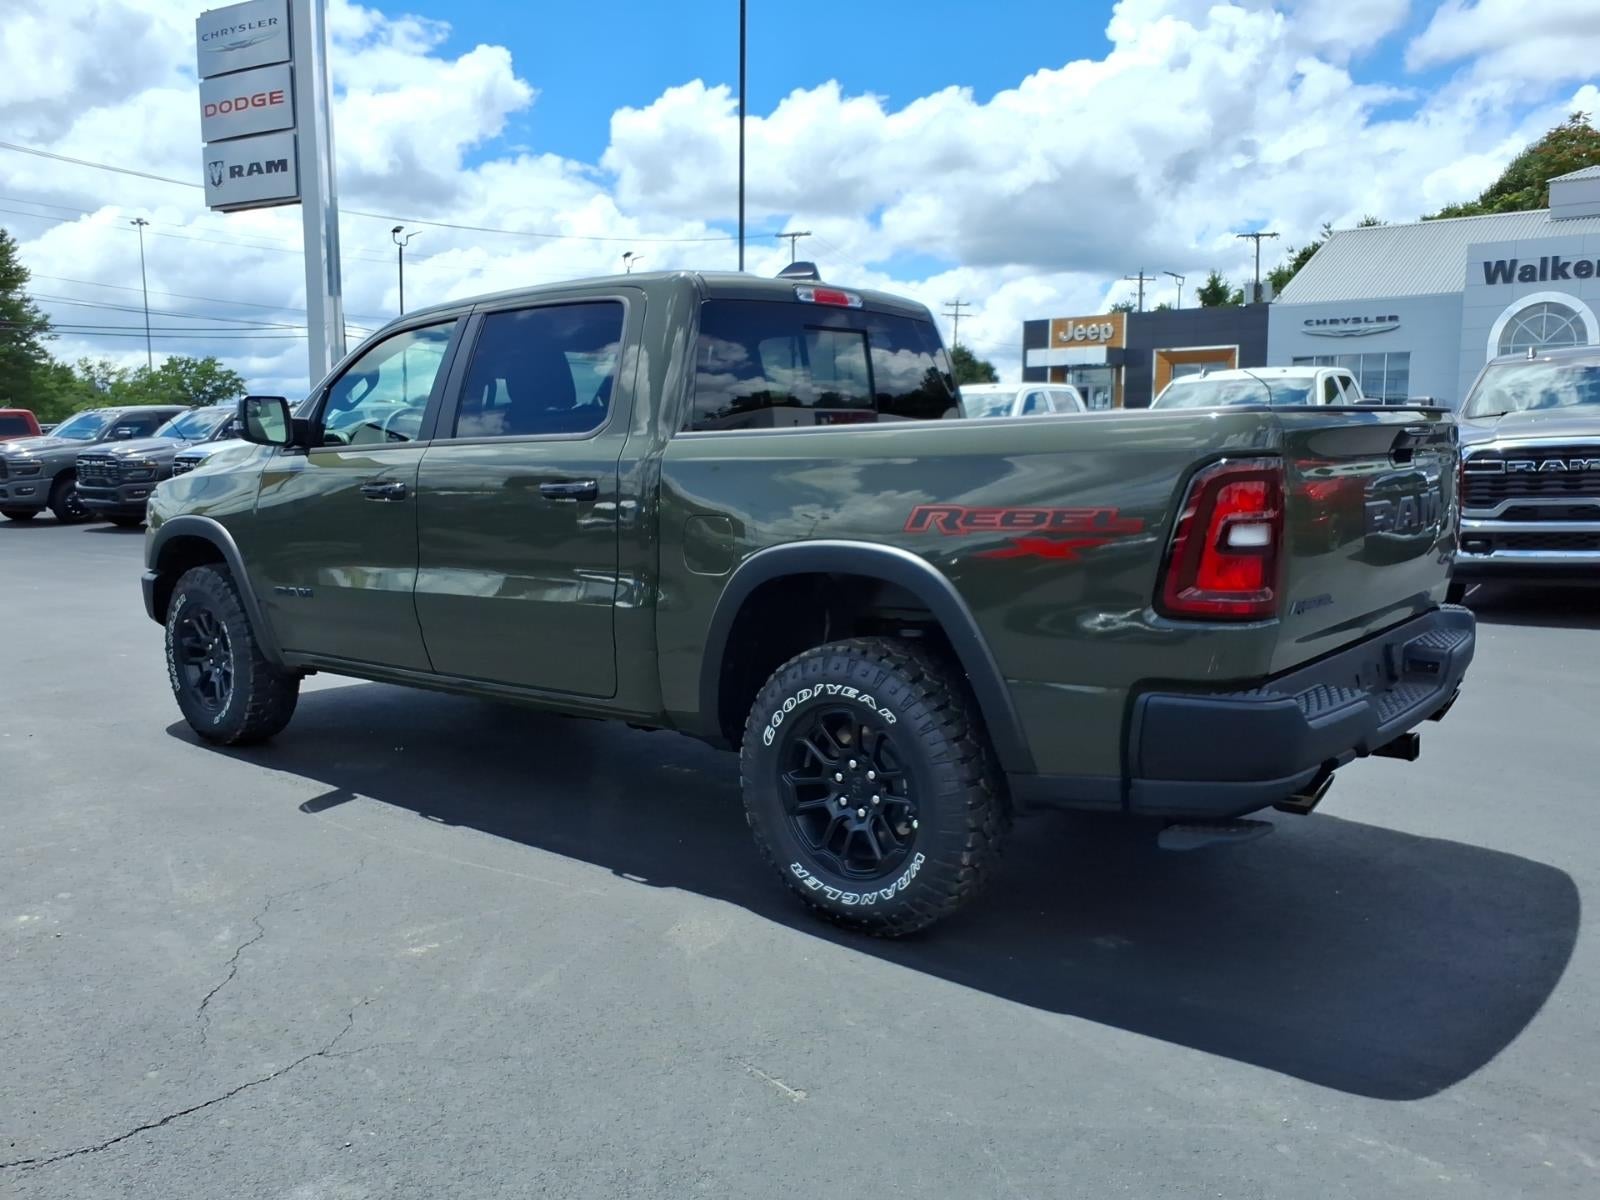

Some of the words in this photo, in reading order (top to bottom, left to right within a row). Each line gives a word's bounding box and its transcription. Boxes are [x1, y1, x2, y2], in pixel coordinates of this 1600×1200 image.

[201, 17, 279, 42] CHRYSLER
[204, 90, 285, 118] DODGE
[229, 159, 288, 179] RAM
[1058, 320, 1114, 344] Jeep
[1303, 315, 1399, 327] CHRYSLER
[1506, 459, 1600, 473] RAM
[903, 504, 1146, 536] REBEL
[789, 852, 926, 905] WRANGLER
